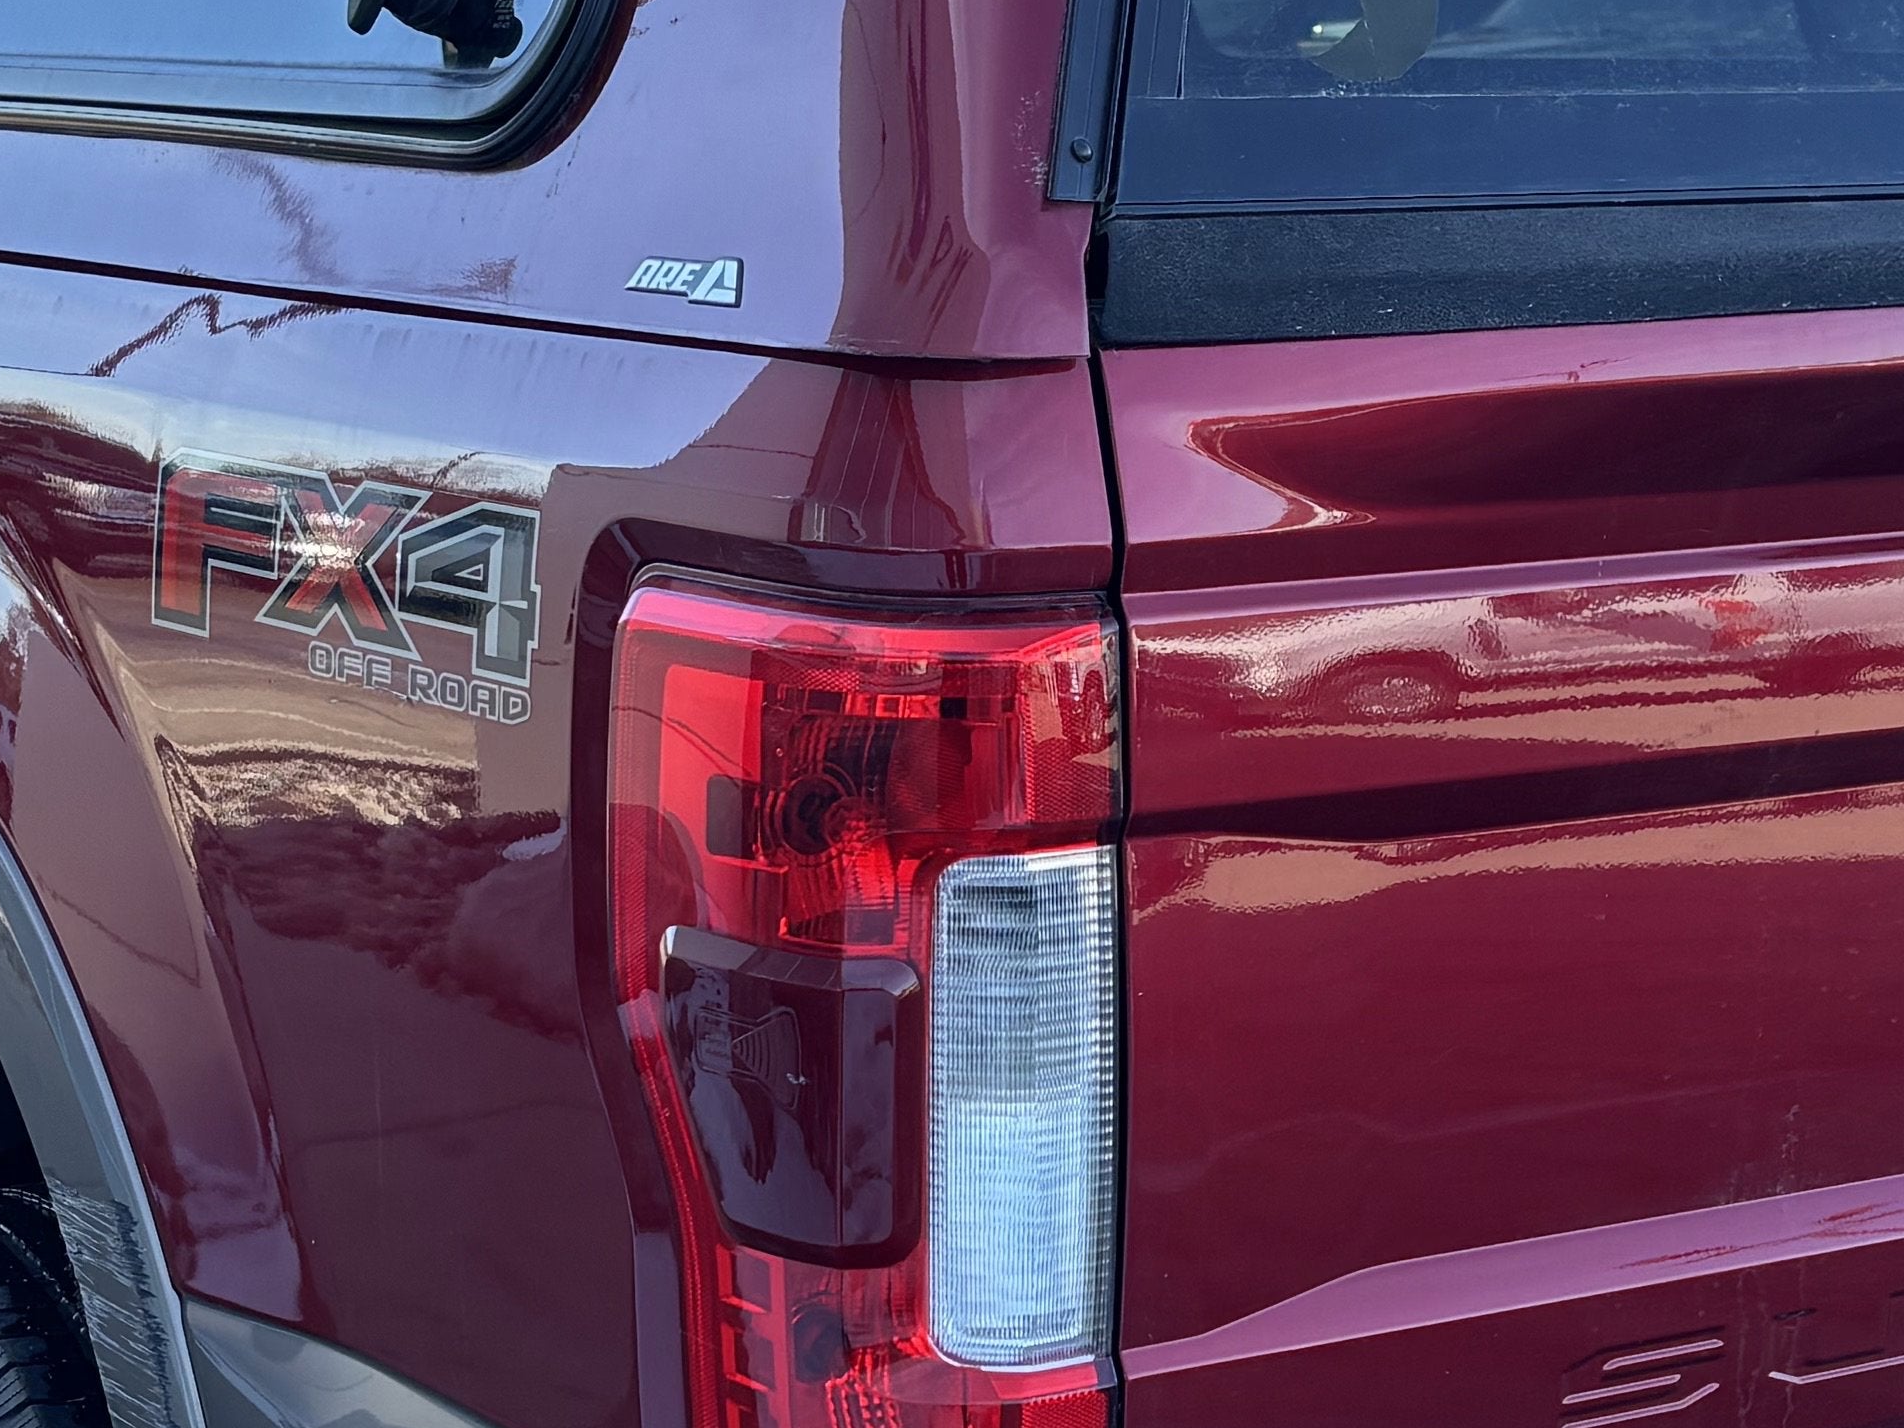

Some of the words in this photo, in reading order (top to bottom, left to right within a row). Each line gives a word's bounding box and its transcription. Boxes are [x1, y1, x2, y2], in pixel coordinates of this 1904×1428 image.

[624, 259, 702, 291] ARE
[151, 446, 542, 688] FX4
[308, 640, 392, 689] OFF
[408, 663, 532, 725] ROAD
